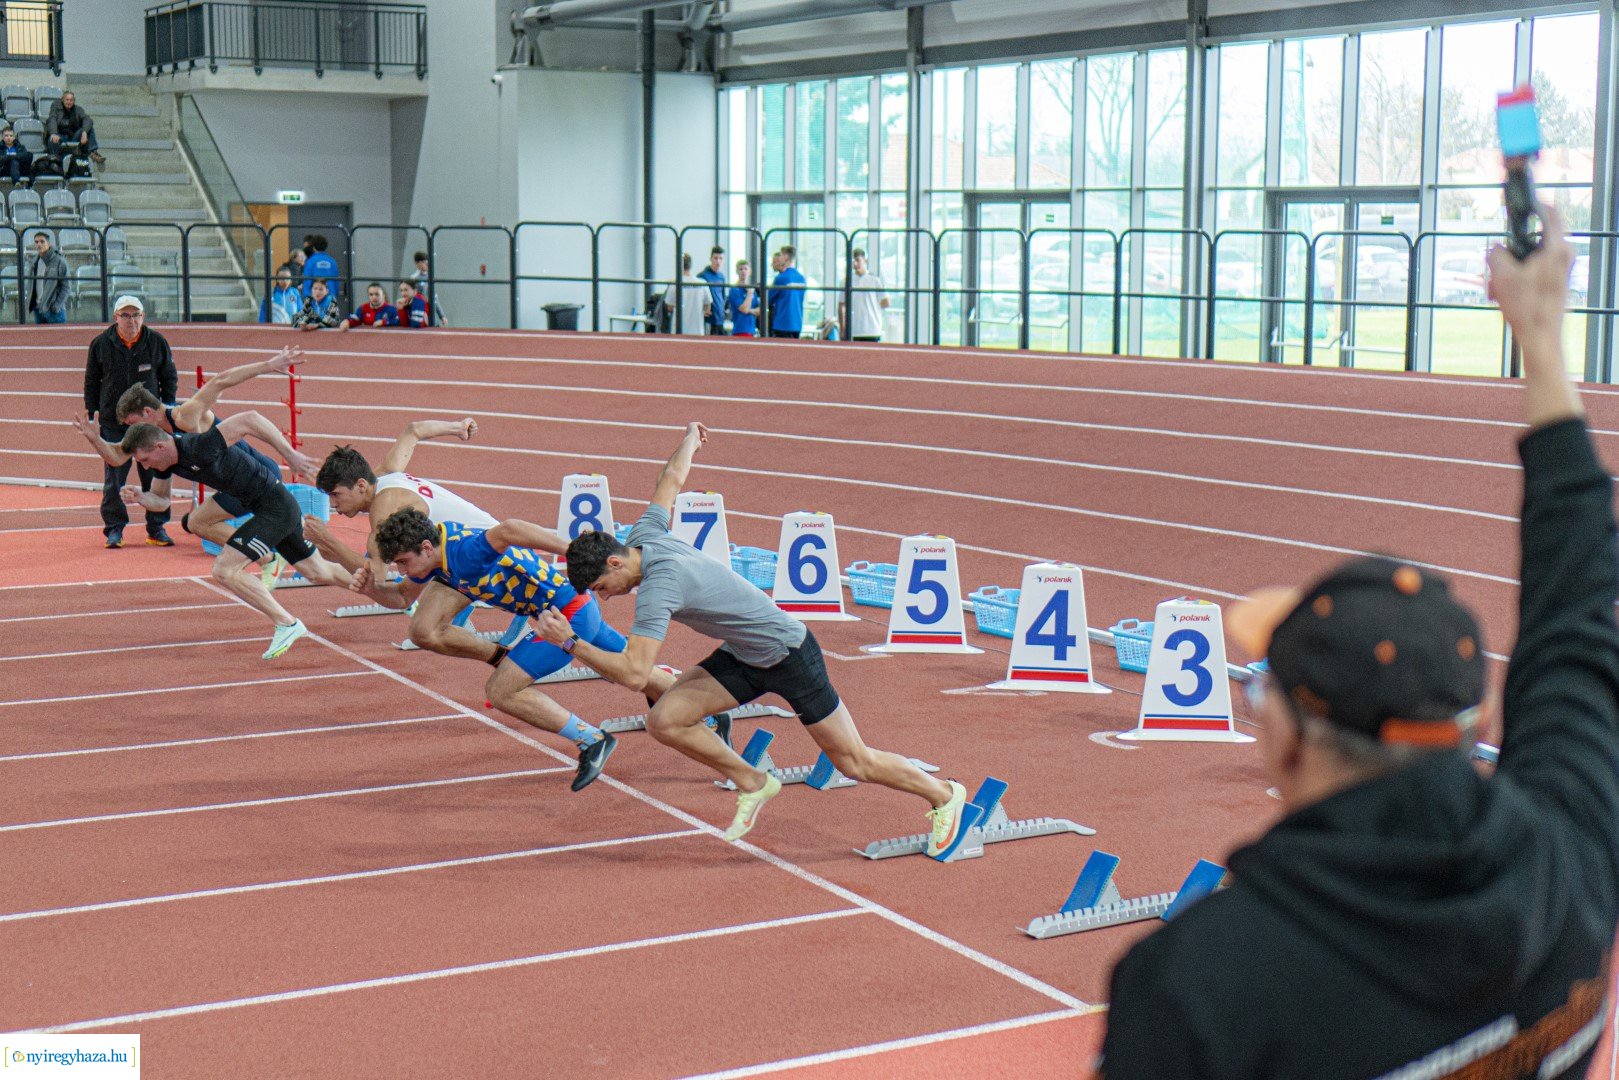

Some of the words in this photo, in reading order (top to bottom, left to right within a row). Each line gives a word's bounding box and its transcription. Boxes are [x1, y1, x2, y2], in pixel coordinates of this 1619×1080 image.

[569, 493, 604, 541] 8
[681, 512, 718, 551] 7
[788, 533, 828, 594] 6
[906, 559, 949, 625] 5
[1025, 590, 1077, 661] 4
[1179, 614, 1210, 622] polanik
[1161, 628, 1213, 707] 3
